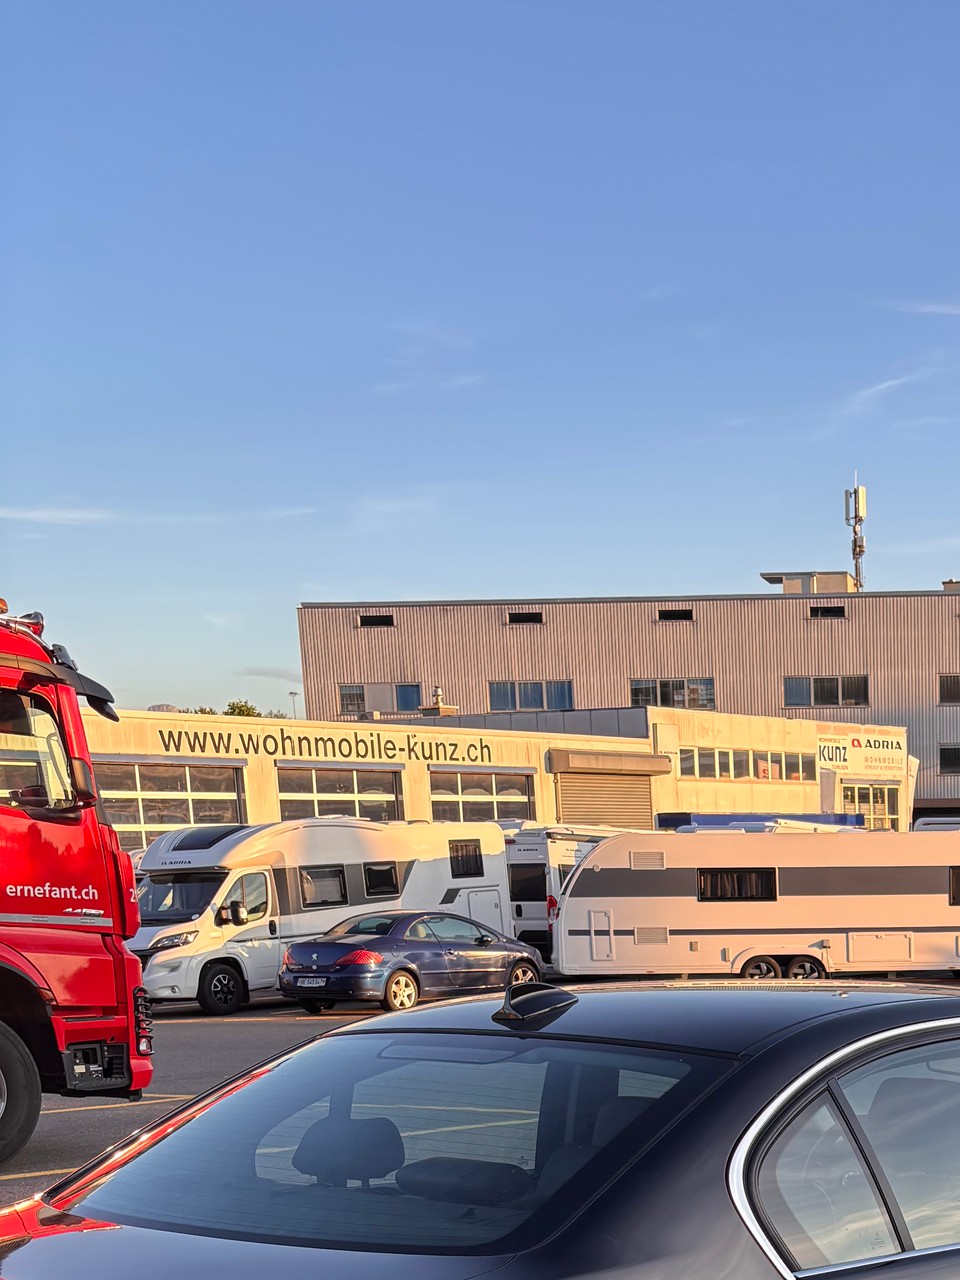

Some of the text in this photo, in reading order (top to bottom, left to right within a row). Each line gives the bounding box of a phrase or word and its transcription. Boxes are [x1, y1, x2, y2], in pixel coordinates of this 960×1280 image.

[158, 728, 492, 763] www.wohnmobile-kunz.ch
[864, 739, 902, 750] ADRIA
[818, 745, 848, 762] KUNZ
[6, 882, 98, 900] ernefant.ch
